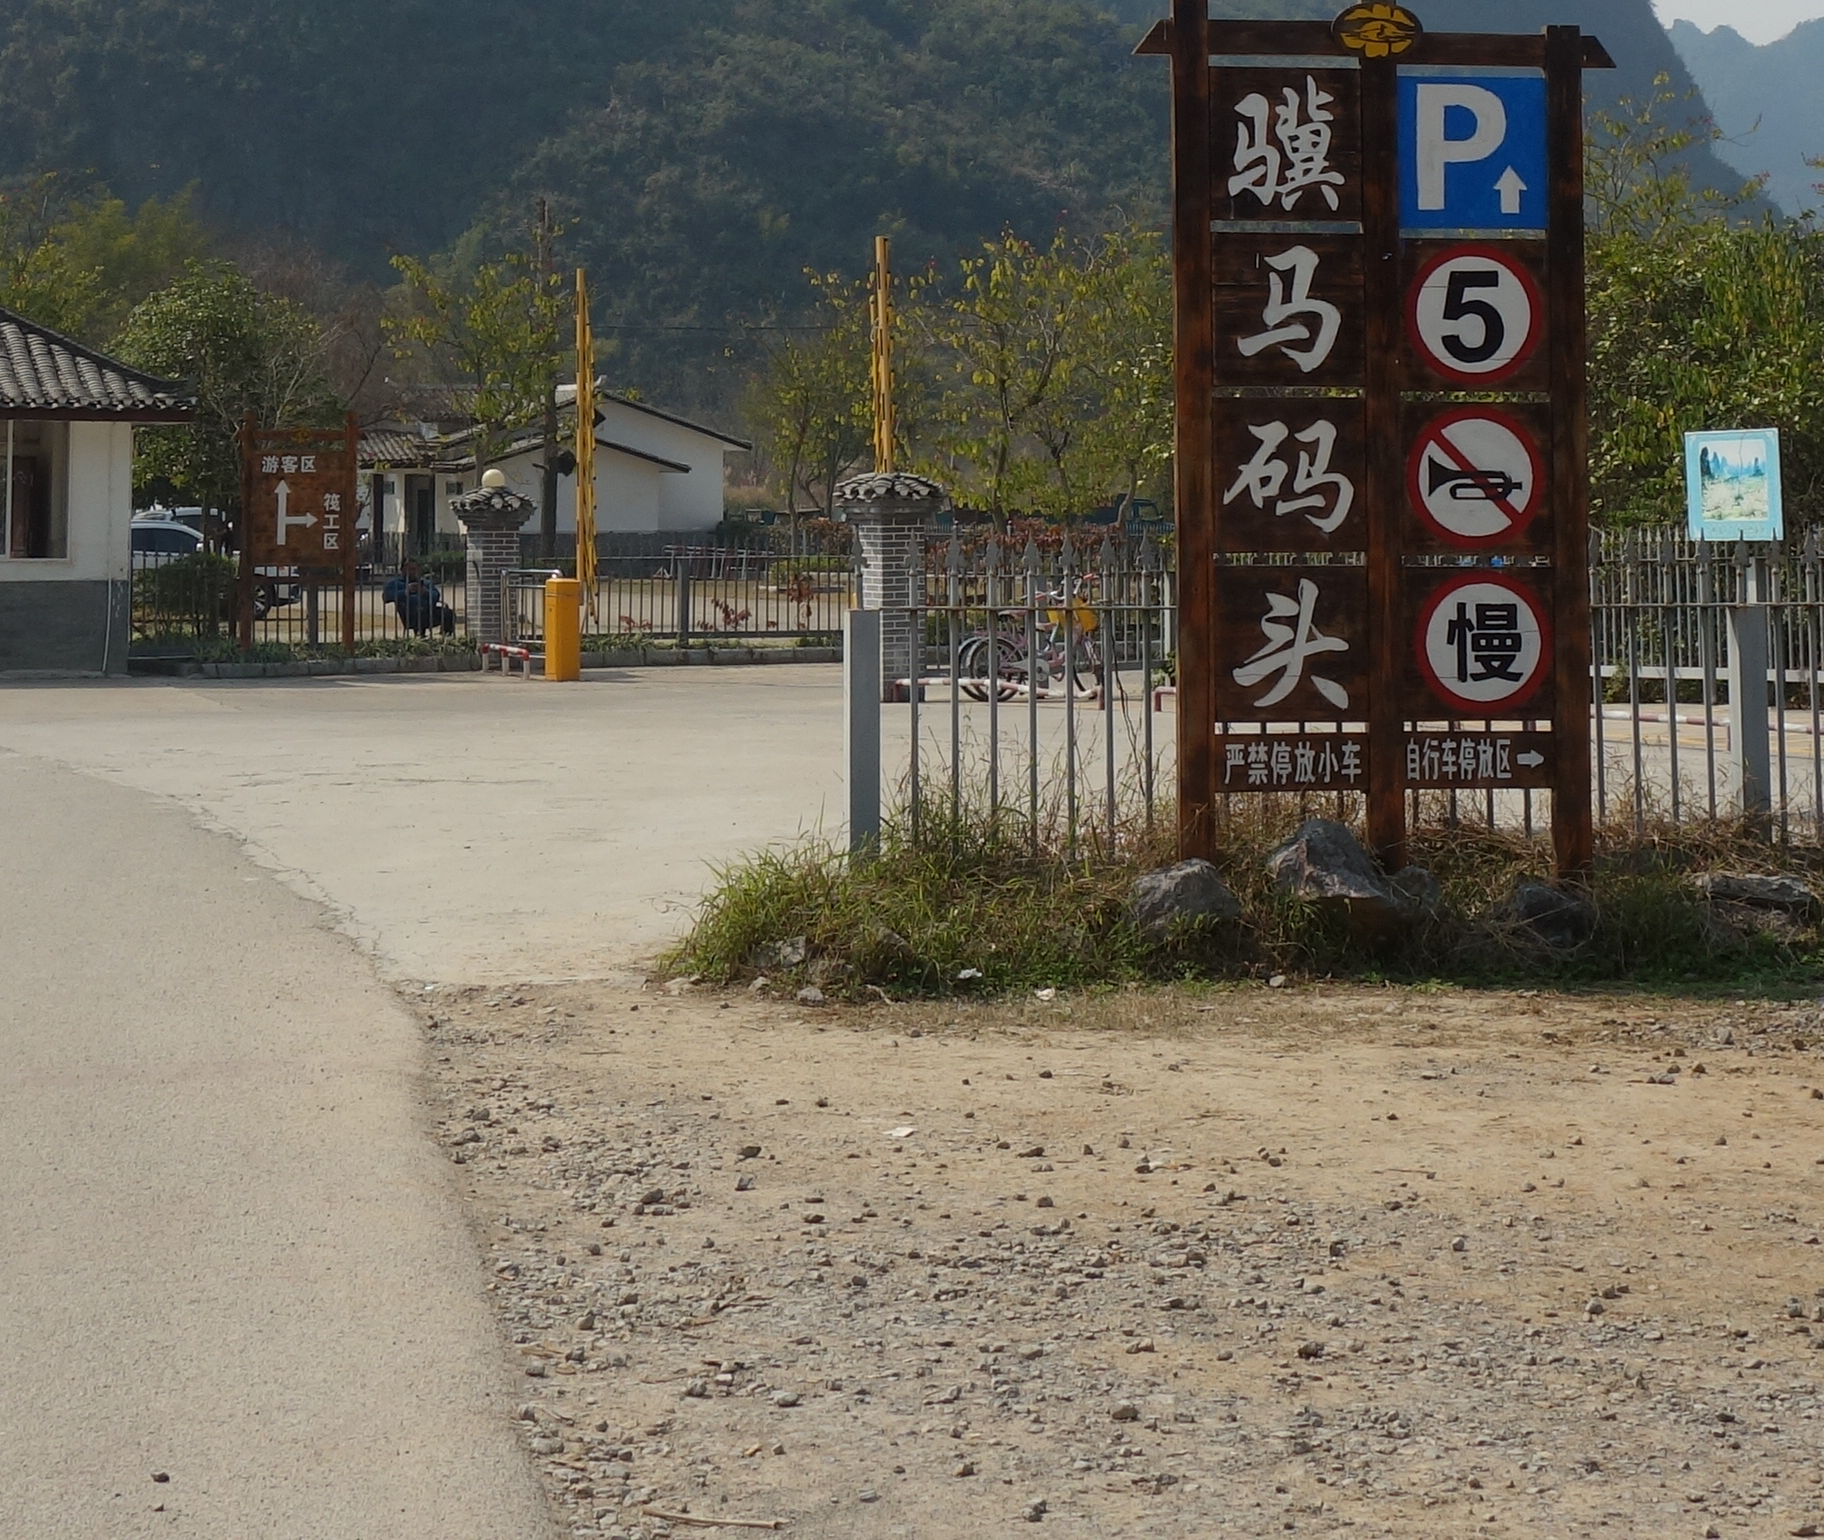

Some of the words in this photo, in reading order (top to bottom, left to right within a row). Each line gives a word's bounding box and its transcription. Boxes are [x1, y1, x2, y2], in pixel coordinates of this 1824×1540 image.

[1415, 82, 1508, 211] P
[1440, 269, 1507, 364] 5
[1222, 74, 1356, 709] 骥马码头
[261, 454, 317, 474] 游客区
[322, 492, 341, 550] 筏工区
[1447, 602, 1524, 684] 慢
[1223, 739, 1363, 786] 严禁停放小车
[1405, 737, 1513, 782] 自行车停放区
